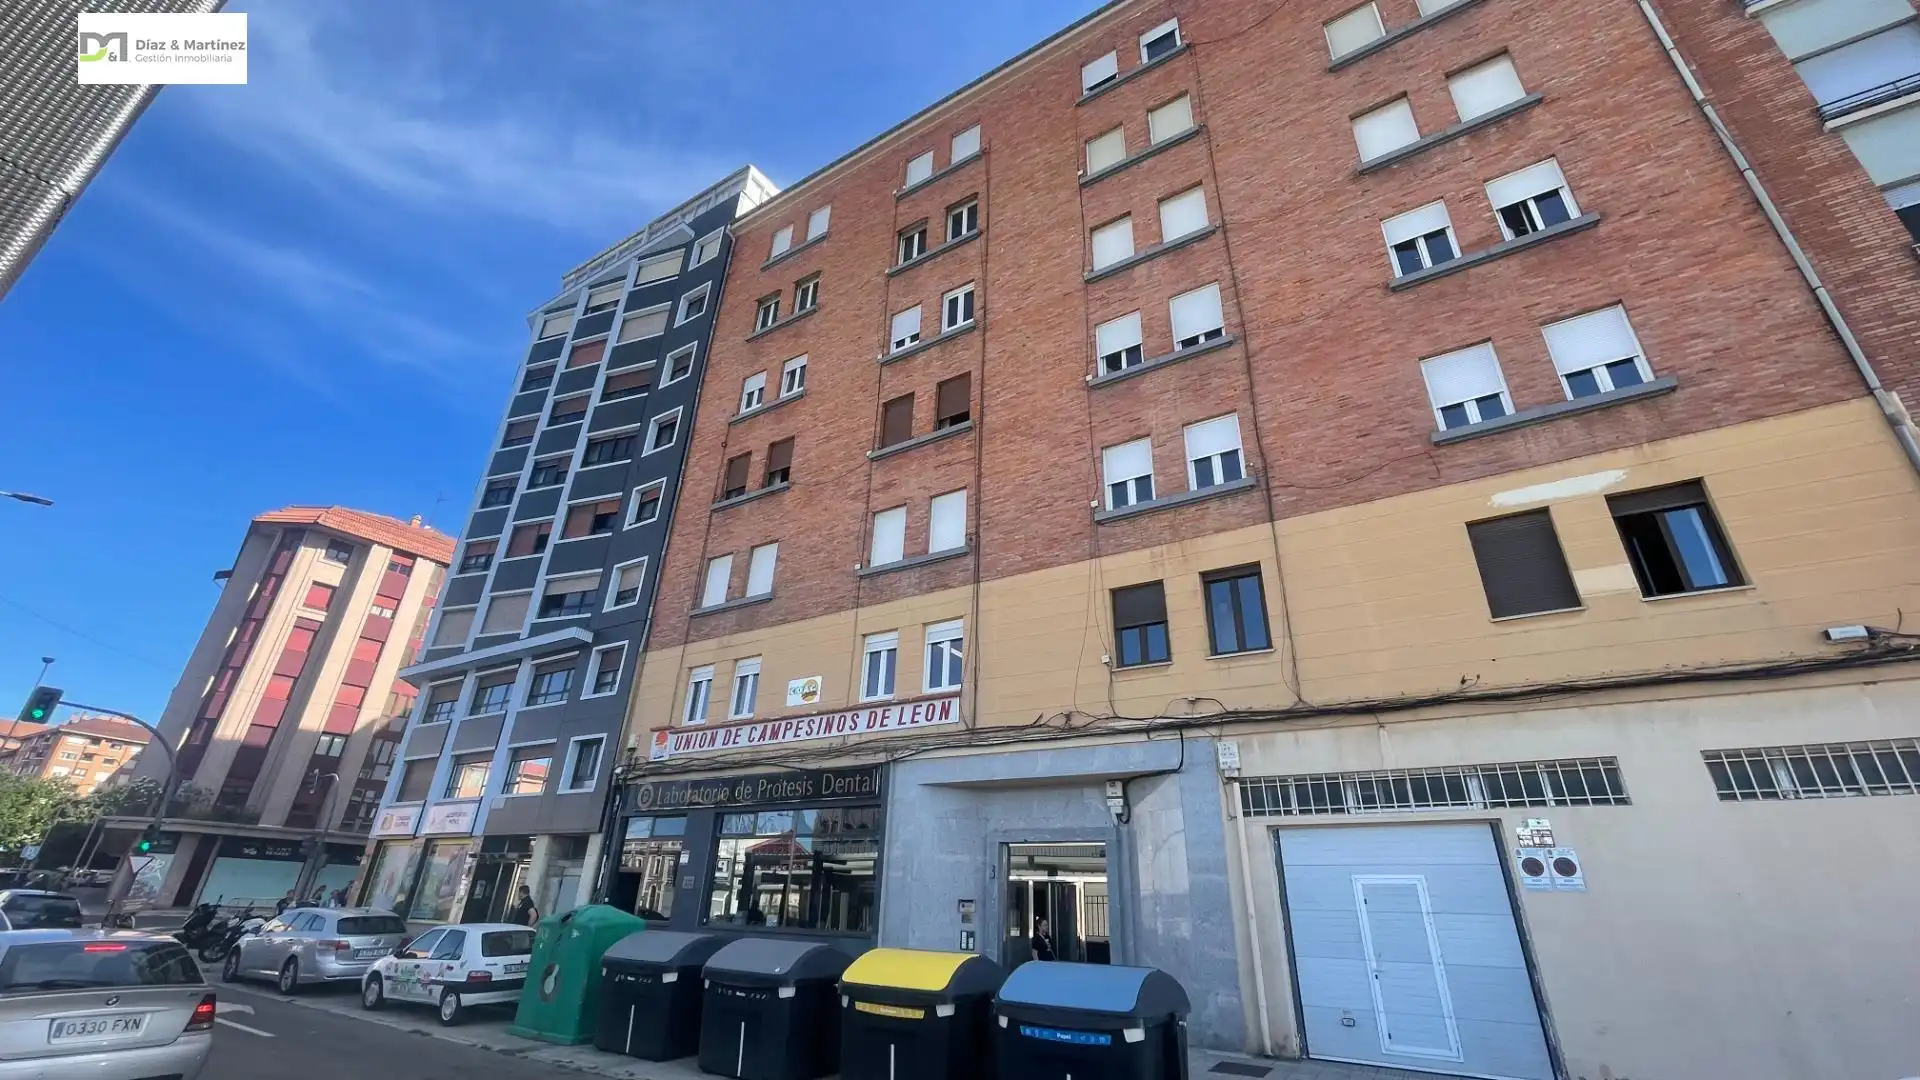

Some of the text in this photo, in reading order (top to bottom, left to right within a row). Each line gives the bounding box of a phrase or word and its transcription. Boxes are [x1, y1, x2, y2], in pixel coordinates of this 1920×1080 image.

[674, 700, 952, 751] UNION DE CAMPESINOS DE LEON
[656, 783, 730, 805] Laboratorio
[735, 780, 752, 800] de
[822, 769, 876, 795] Dental
[990, 864, 996, 880] 3
[66, 1017, 142, 1036] 0330 FXN
